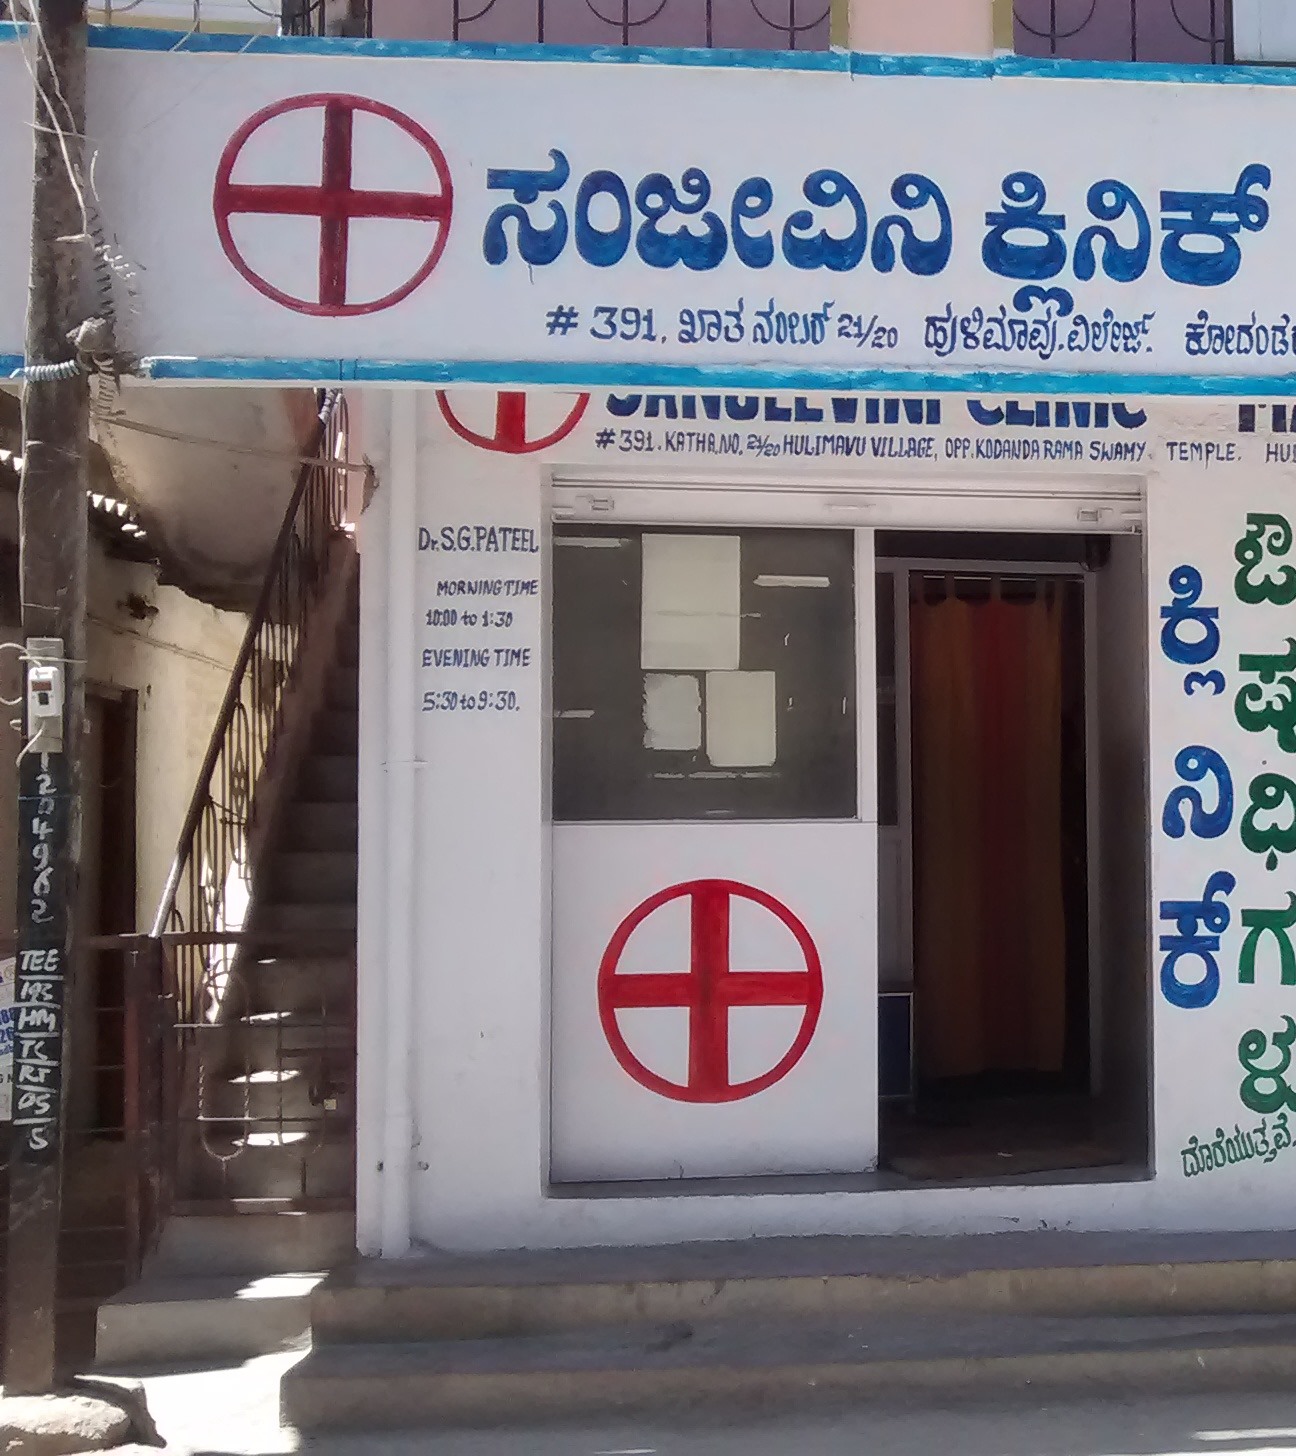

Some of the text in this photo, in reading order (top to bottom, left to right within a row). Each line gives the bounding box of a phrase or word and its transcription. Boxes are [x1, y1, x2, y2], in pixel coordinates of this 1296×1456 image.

[482, 148, 1272, 315] ಸಂಜೀವಿನಿ ಕ್ಲಿನಿಕ್
[783, 434, 867, 457] HULIMAVU
[870, 436, 938, 461] VILLAGE,
[1042, 439, 1083, 460] RAMA
[436, 579, 539, 597] MORNING TIME
[460, 610, 478, 627] to
[421, 648, 531, 668] EVENING TIME
[459, 694, 476, 711] to
[20, 948, 60, 972] TEE
